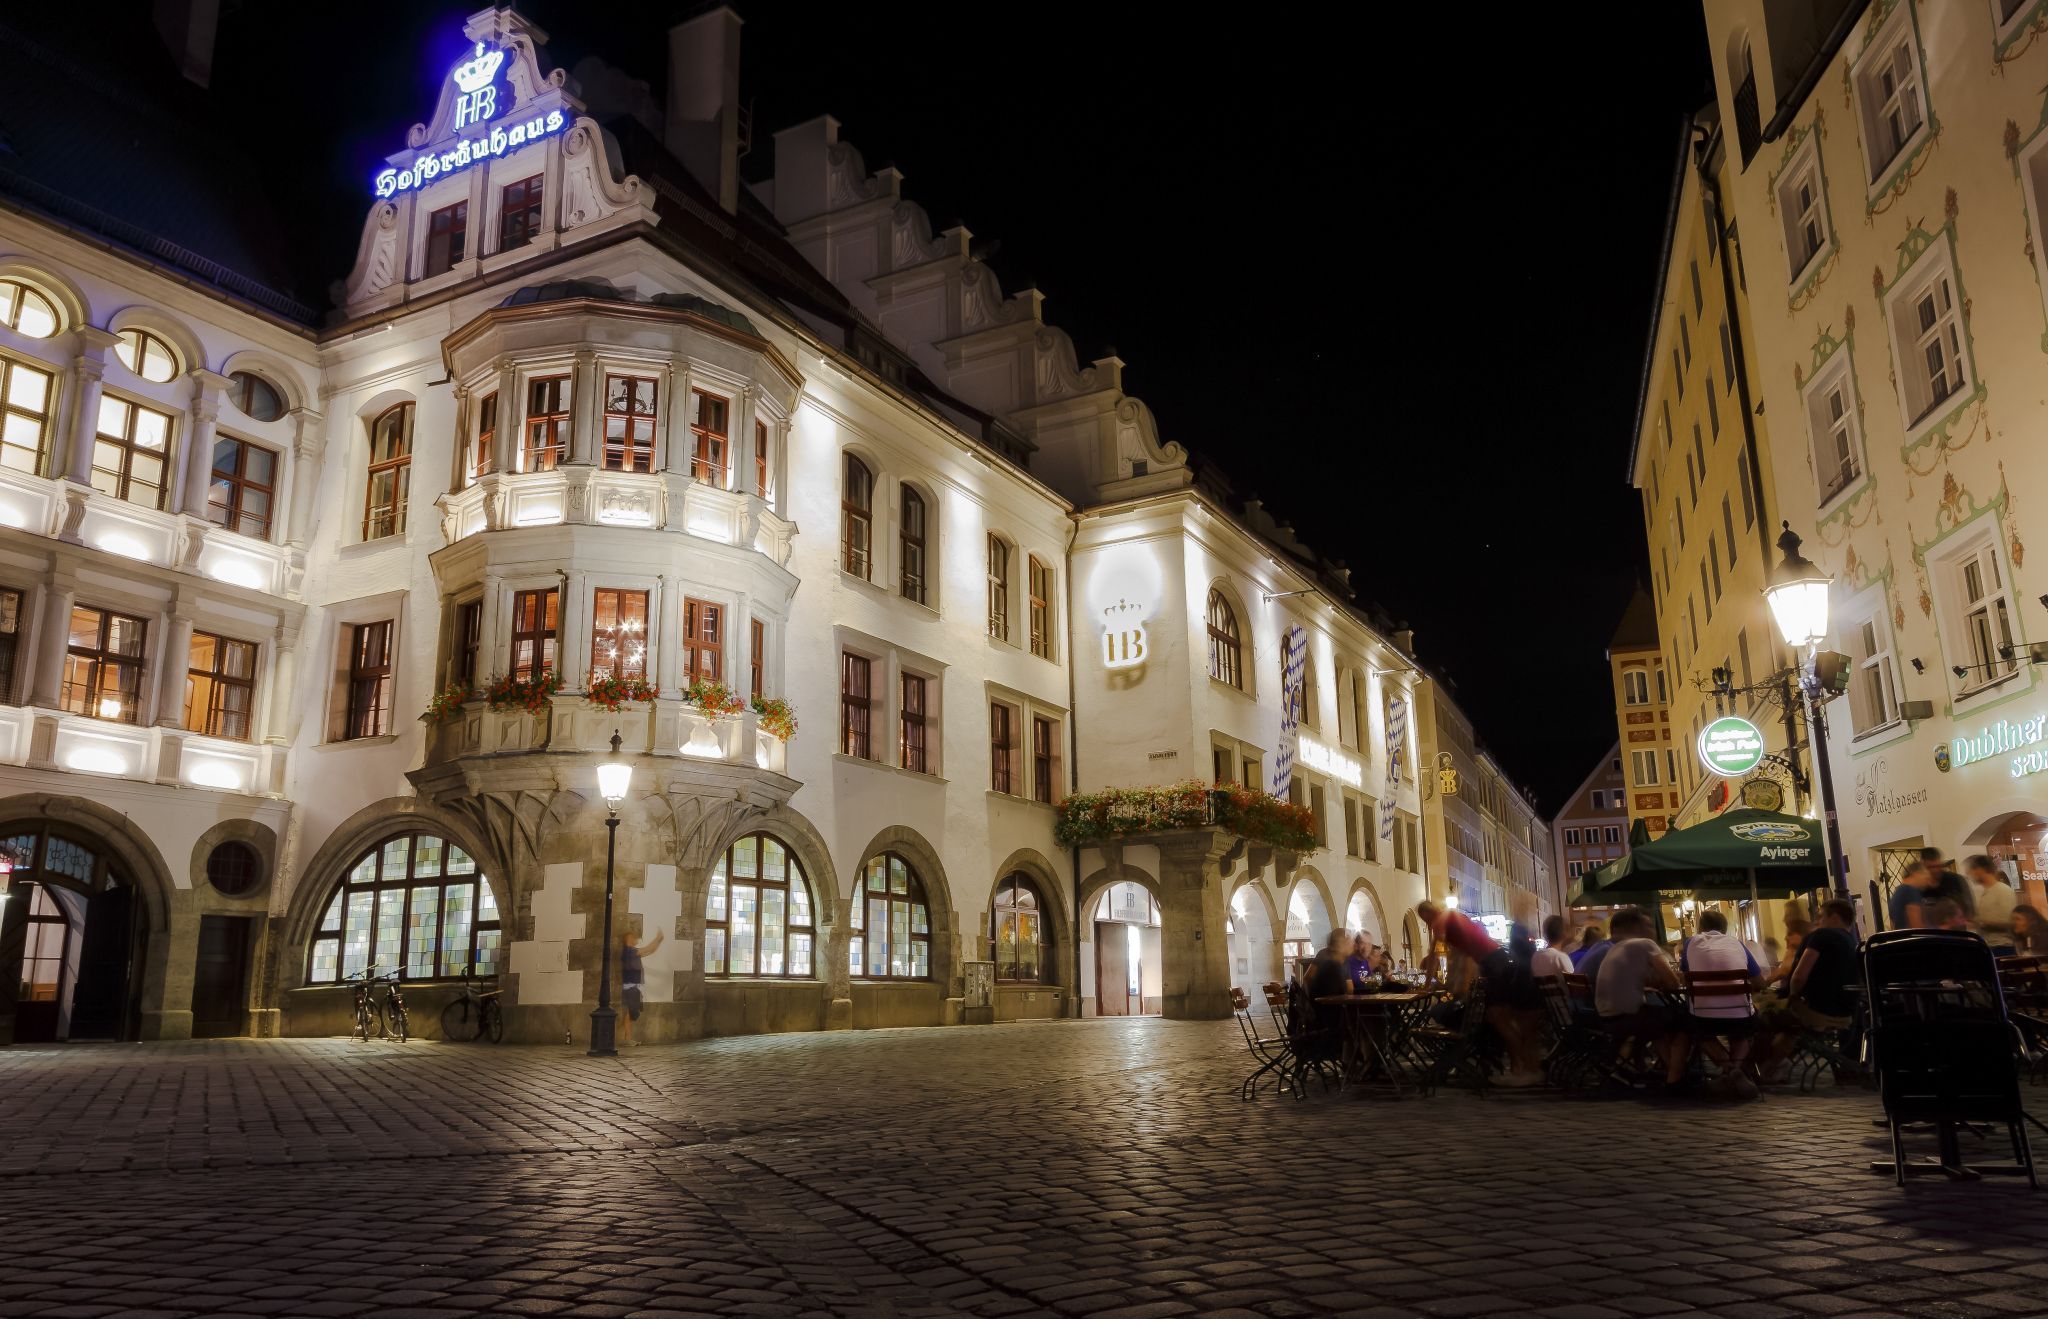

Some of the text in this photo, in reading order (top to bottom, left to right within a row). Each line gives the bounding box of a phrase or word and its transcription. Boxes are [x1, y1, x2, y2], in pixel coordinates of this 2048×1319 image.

[452, 85, 497, 133] HB
[375, 109, 565, 199] Hofbräuhaus
[1952, 714, 2046, 768] Dubliner
[1440, 779, 1457, 793] HB
[1760, 845, 1810, 860] Ayinger
